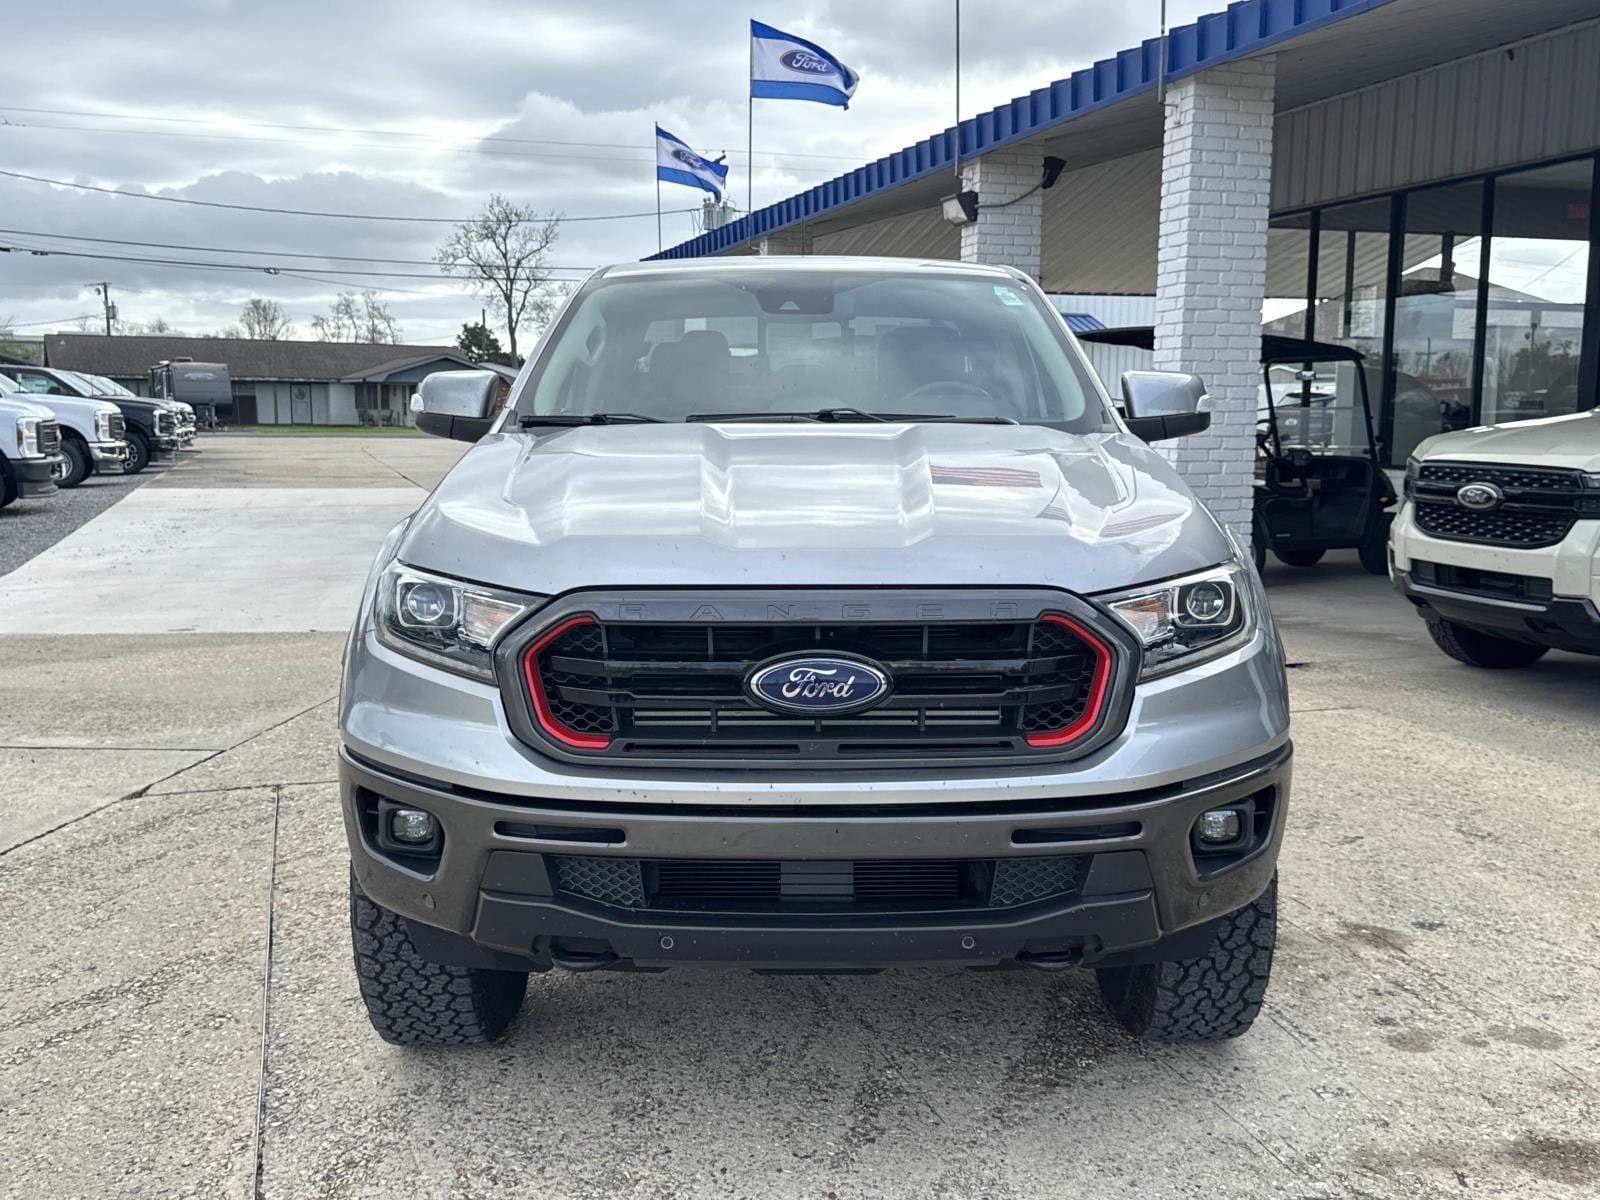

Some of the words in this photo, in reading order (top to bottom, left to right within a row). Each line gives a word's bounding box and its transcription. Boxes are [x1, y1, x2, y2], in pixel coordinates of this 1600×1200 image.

[792, 52, 828, 72] Ford
[618, 601, 1019, 619] RANGER
[782, 667, 855, 698] Ford
